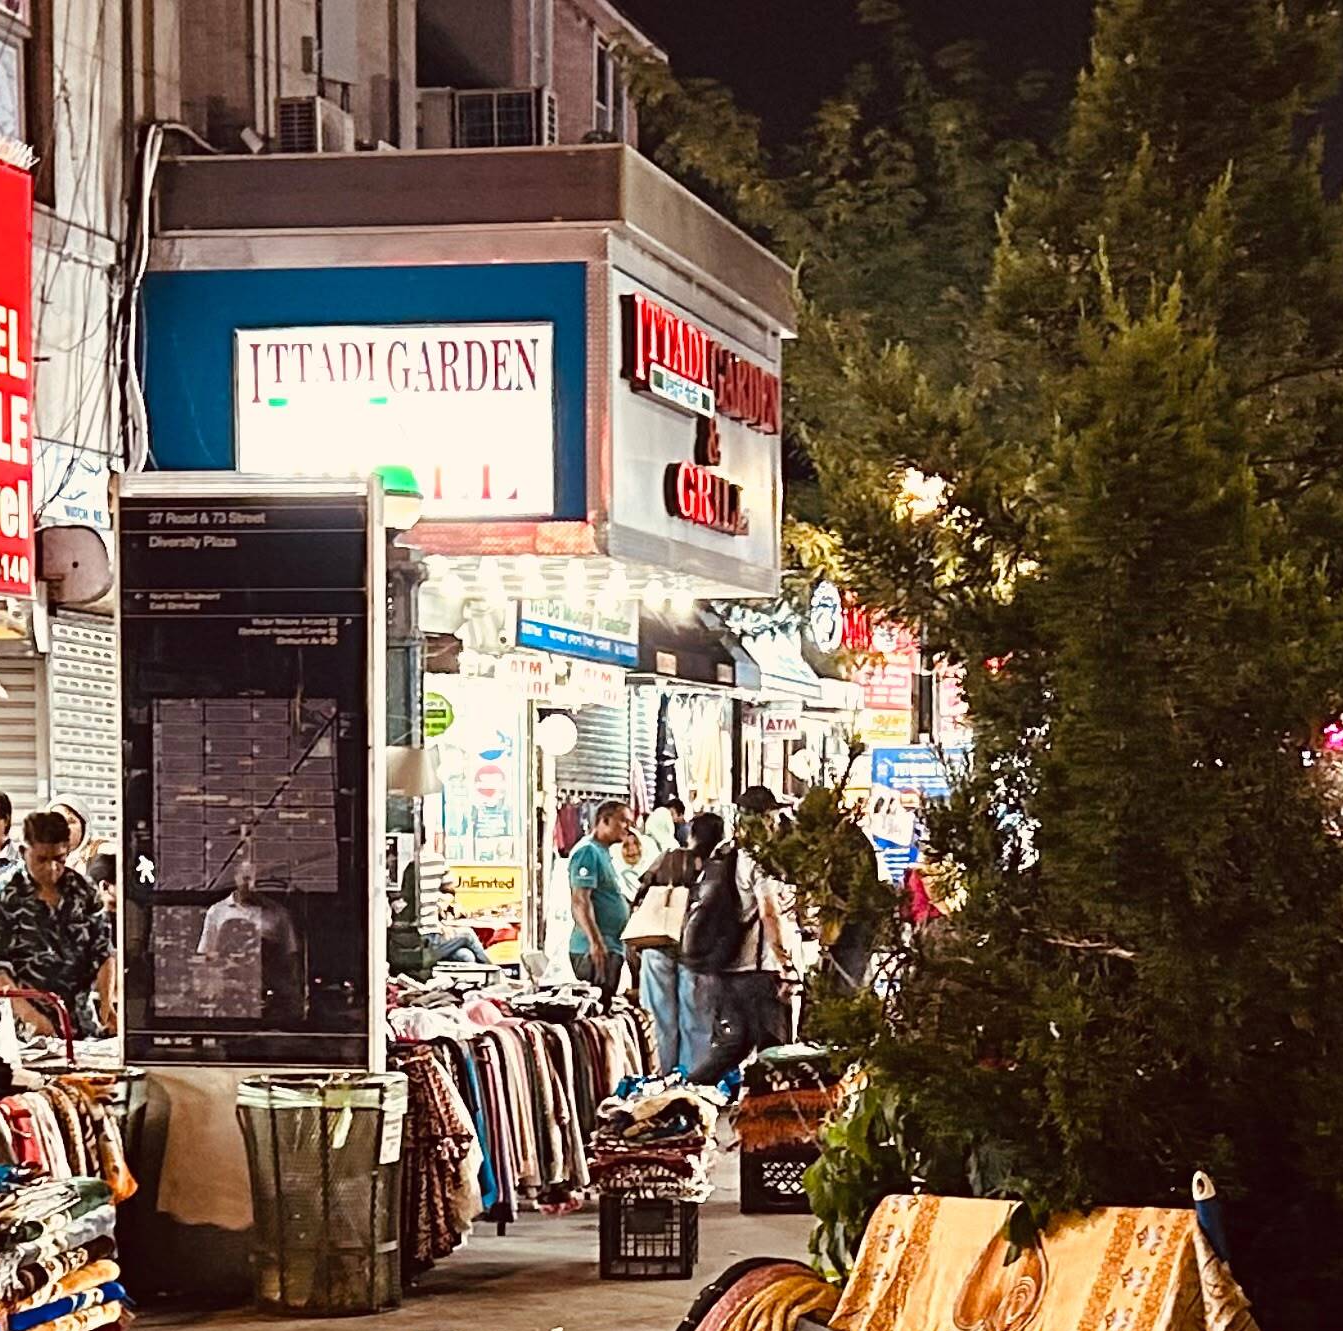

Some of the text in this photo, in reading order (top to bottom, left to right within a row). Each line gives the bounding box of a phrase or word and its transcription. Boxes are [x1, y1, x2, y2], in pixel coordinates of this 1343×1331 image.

[634, 291, 709, 388] ITTADI
[249, 338, 539, 403] ITTADI GARDEN
[148, 512, 164, 525] 37
[211, 511, 227, 525] 73
[765, 719, 797, 731] ATM
